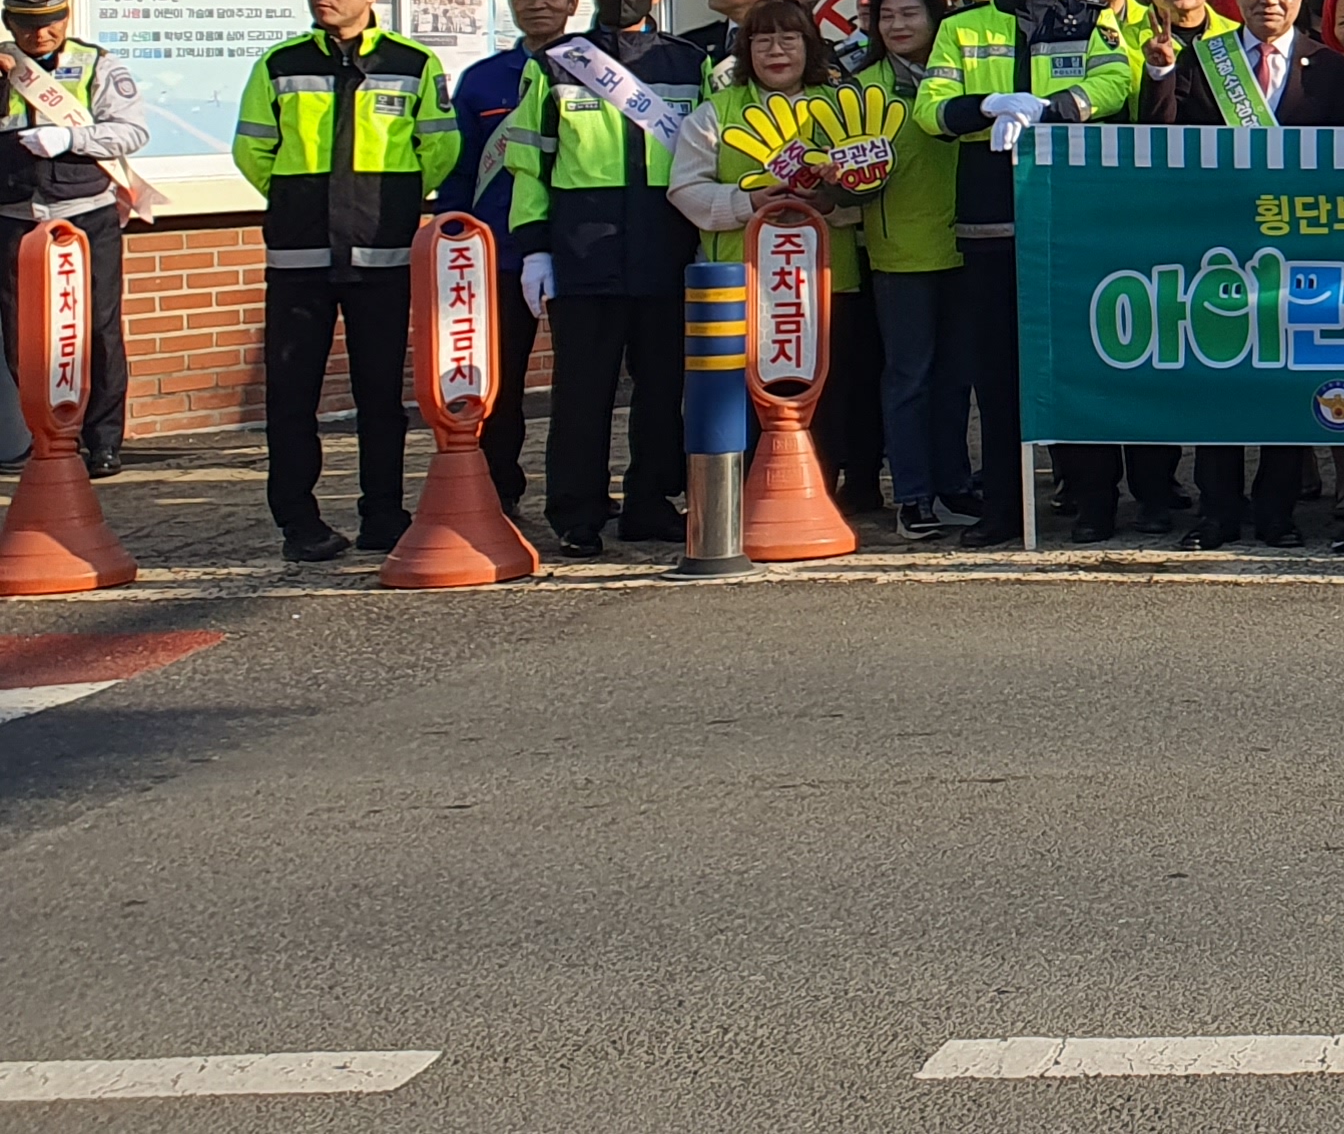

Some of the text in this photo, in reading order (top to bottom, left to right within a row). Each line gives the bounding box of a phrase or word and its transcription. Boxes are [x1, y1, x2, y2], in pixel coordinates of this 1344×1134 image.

[18, 65, 86, 127] 보행자
[829, 137, 890, 169] 무관심
[841, 160, 889, 190] OUT
[56, 252, 78, 392] 주차금지
[447, 246, 476, 386] 주차금지
[769, 232, 806, 369] 주차금지
